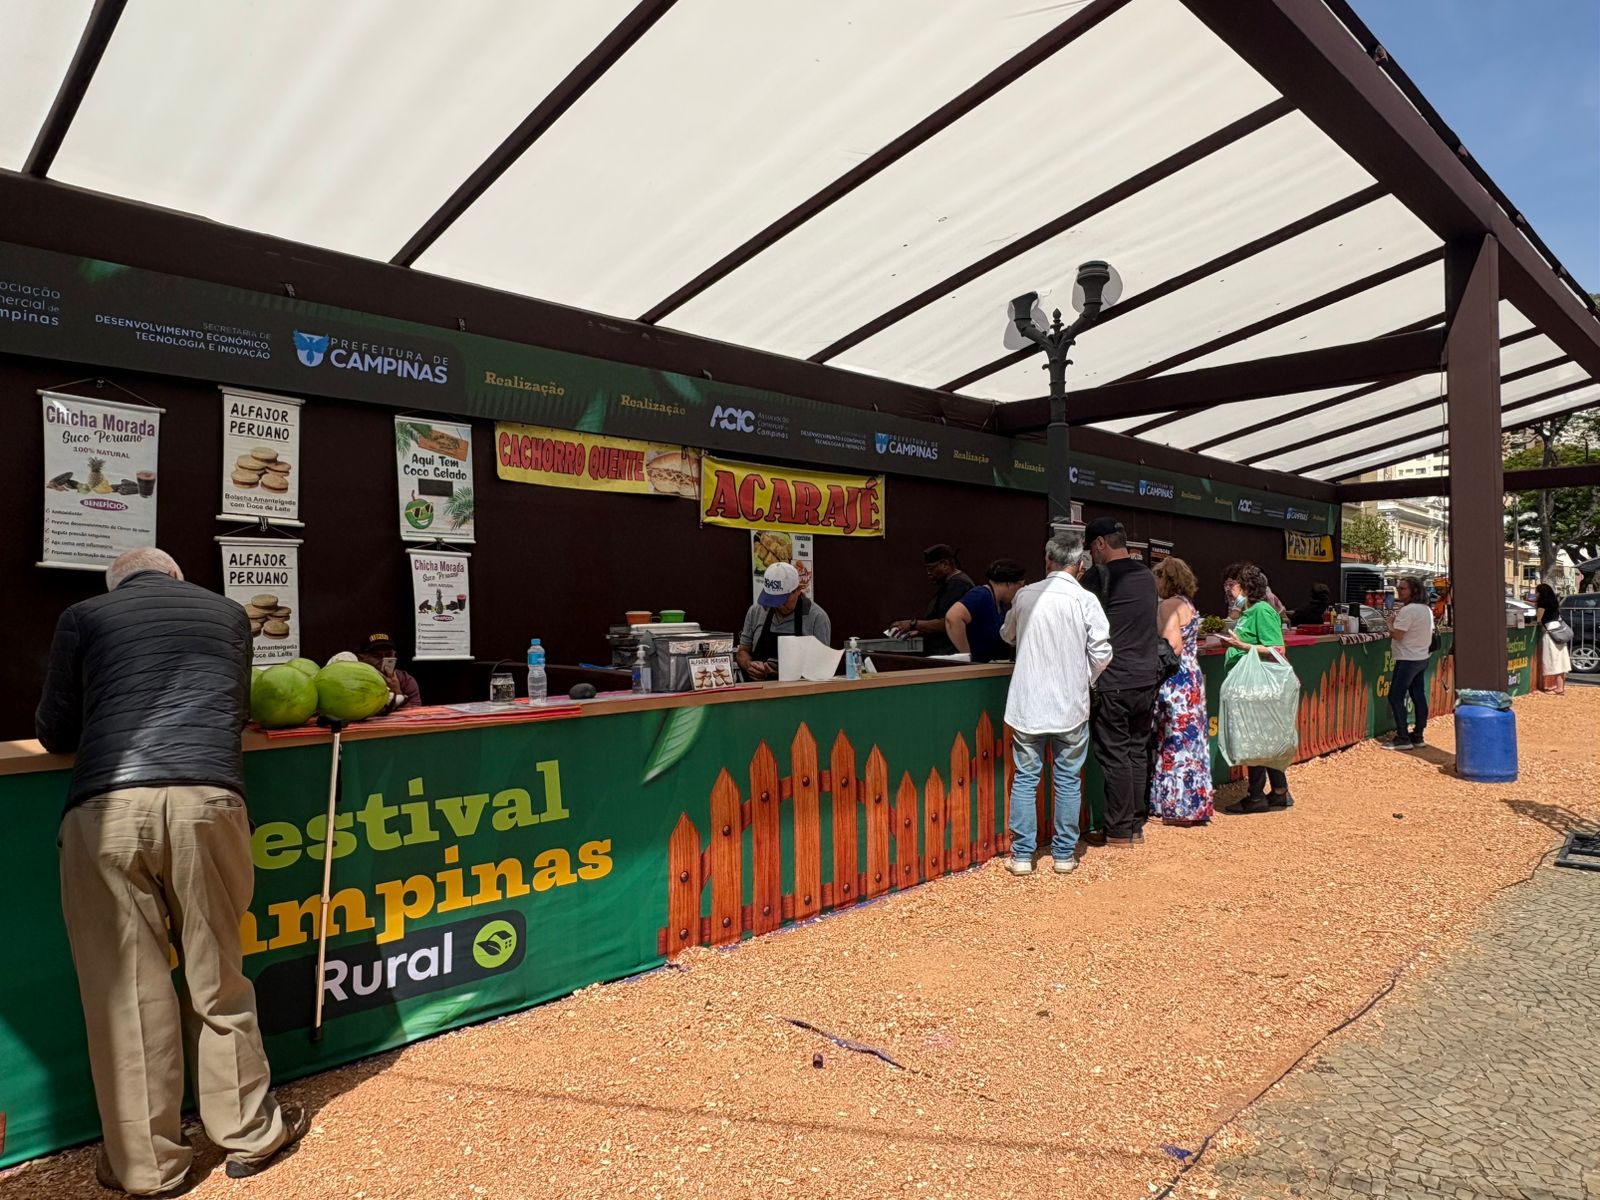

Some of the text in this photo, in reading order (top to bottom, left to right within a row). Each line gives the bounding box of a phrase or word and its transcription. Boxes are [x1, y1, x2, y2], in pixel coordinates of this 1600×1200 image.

[0, 281, 60, 299] ociação
[0, 308, 59, 326] mpinas
[48, 305, 60, 313] de
[95, 314, 271, 350] DESENVOLVIMENTO ECONÔMICO,
[203, 322, 272, 340] SECRETARIA DE
[136, 331, 271, 360] TECNOLOGIA E INOVAÇÃO
[331, 337, 449, 366] PREFEITURA DE
[330, 349, 448, 384] CAMPINAS
[484, 371, 565, 396] Realização
[230, 403, 289, 423] ALFAJOR
[621, 394, 686, 416] Realização
[46, 406, 155, 437] Chicha Morada
[710, 405, 756, 433] ACIC
[62, 430, 145, 444] Suco Peruano
[229, 421, 290, 440] PERUANO
[73, 446, 130, 459] 100% NATURAL
[499, 432, 585, 476] CACHORRO
[588, 445, 646, 481] QUENTE
[889, 440, 938, 460] CAMPINAS
[953, 449, 989, 464] Realização
[411, 453, 459, 468] Aqui Tem
[1014, 459, 1045, 473] Realização
[403, 464, 467, 480] Coco Gelado
[1069, 466, 1079, 484] IC
[225, 493, 296, 506] Bolacha Amanteigada
[1146, 485, 1174, 499] CAMPINAS
[83, 500, 126, 511] BENEFÍCIOS
[246, 502, 264, 510] Doce
[707, 469, 880, 534] ACARAJÉ
[229, 553, 287, 566] ALFAJOR
[414, 559, 465, 573] Chicha Morada
[229, 571, 289, 585] PERUANO
[253, 651, 267, 659] oce
[251, 759, 570, 871] estival
[241, 838, 613, 956] mpinas
[320, 932, 452, 1002] Rural
